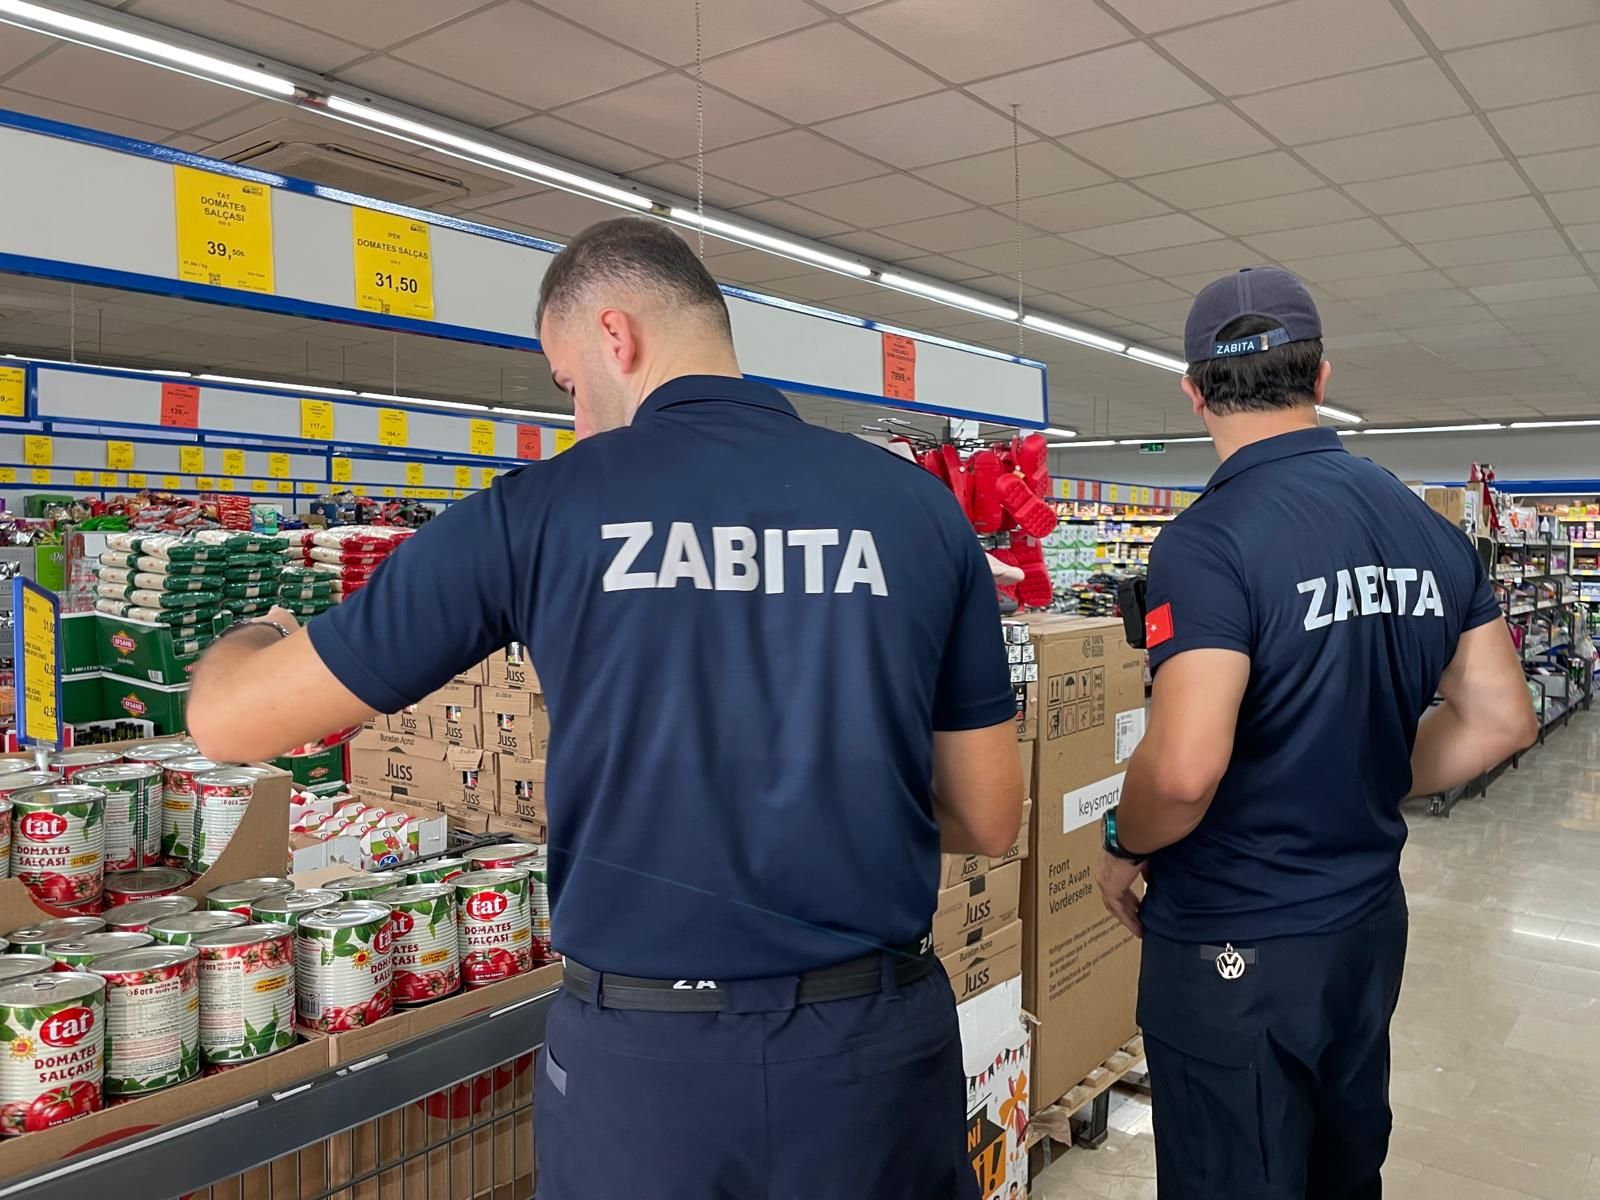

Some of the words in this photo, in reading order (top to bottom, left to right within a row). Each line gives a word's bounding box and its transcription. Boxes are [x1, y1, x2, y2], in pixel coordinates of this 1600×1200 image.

[201, 196, 247, 212] DOMATES
[204, 207, 245, 222] SALÇASI
[357, 238, 397, 252] DOMATES
[375, 272, 418, 293] 31,50
[1216, 341, 1255, 354] ZABITA
[601, 521, 888, 597] ZABITA
[1296, 565, 1445, 632] ZABITA
[504, 666, 525, 683] Juss
[400, 714, 417, 729] Juss
[445, 723, 463, 739] Juss
[498, 731, 517, 748] Juss
[385, 757, 413, 781] Juss
[462, 789, 480, 805] Juss
[1079, 786, 1119, 817] keysmart
[515, 800, 536, 817] Juss
[26, 817, 61, 835] tat
[16, 846, 71, 856] DOMATES
[19, 857, 66, 869] SALÇASI
[961, 859, 978, 877] Juss
[1049, 859, 1070, 878] Front
[1049, 880, 1066, 896] Face
[1068, 866, 1090, 886] Avant
[471, 896, 503, 915] tat
[1049, 884, 1092, 914] Vorderseite
[963, 899, 992, 927] Juss
[464, 922, 512, 935] DOMATES
[468, 934, 509, 946] SALÇASI
[962, 967, 990, 997] Juss
[48, 1011, 90, 1041] tat
[34, 1043, 97, 1070] DOMATES
[39, 1059, 95, 1083] SALÇASI
